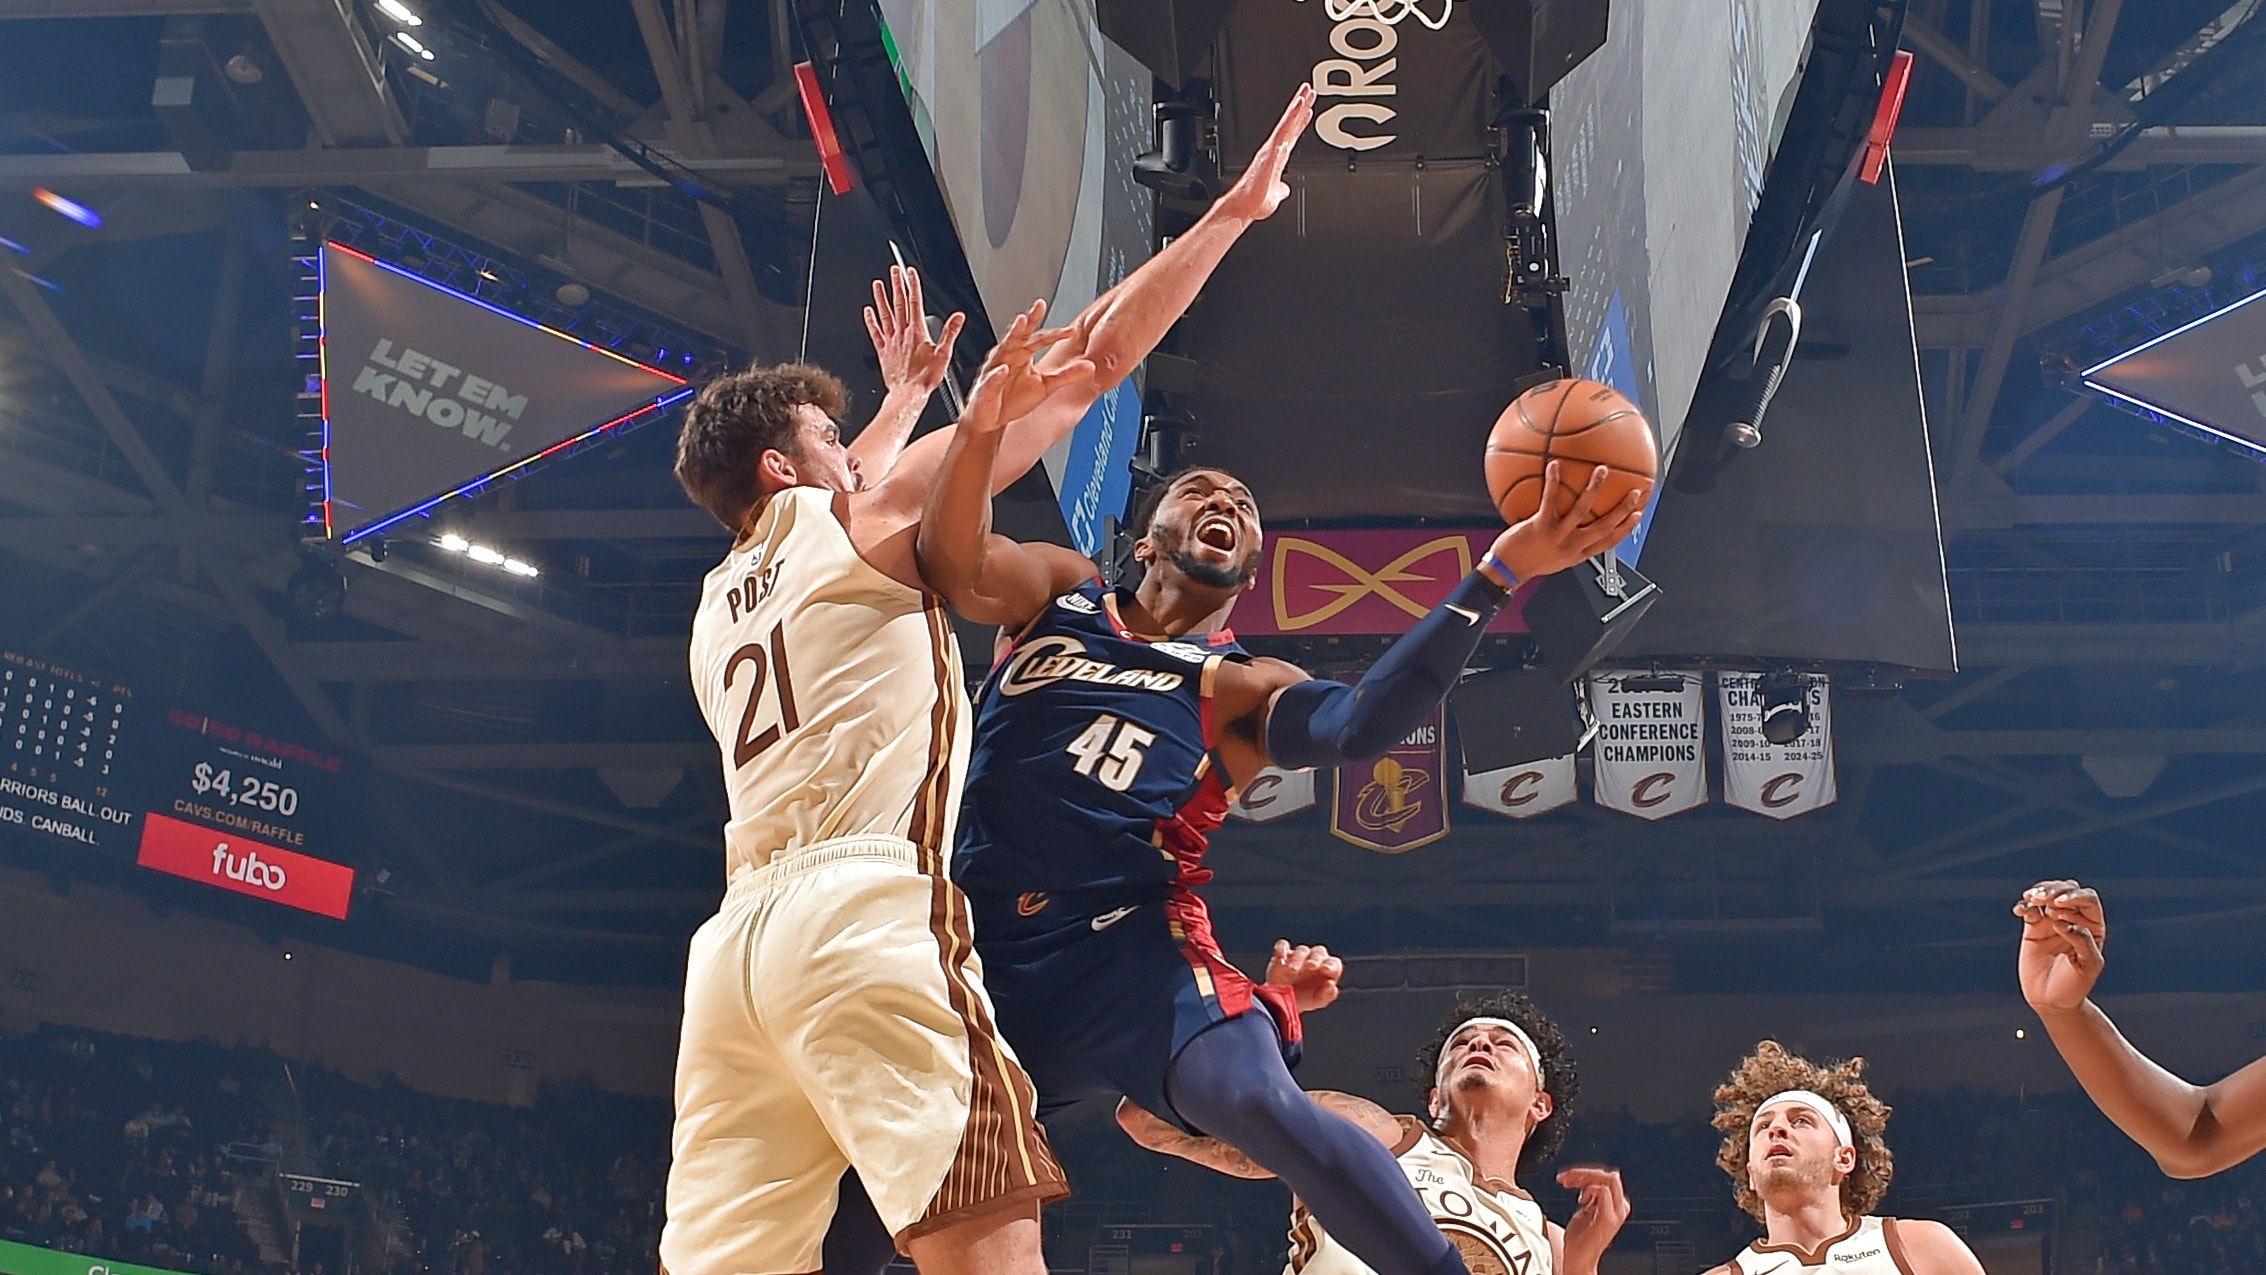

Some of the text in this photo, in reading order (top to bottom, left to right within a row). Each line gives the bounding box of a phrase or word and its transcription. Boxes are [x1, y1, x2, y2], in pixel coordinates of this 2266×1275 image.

[370, 338, 529, 420] LET EM
[352, 366, 513, 451] KNOW.
[1083, 409, 1114, 521] Cleveland
[726, 558, 786, 624] POST
[5, 670, 13, 680] 0
[28, 678, 36, 688] 0
[49, 683, 55, 693] 1
[66, 689, 74, 699] 0
[114, 704, 122, 714] 0
[724, 618, 800, 771] 21
[22, 709, 30, 719] 0
[42, 714, 48, 724] 1
[60, 720, 68, 730] 0
[108, 734, 116, 744] 2
[25, 694, 33, 704] 0
[44, 700, 52, 710] 0
[63, 705, 71, 715] 0
[111, 720, 119, 730] 0
[1611, 702, 1683, 719] EASTERN
[15, 740, 23, 750] 0
[34, 745, 42, 755] 0
[54, 750, 60, 760] 1
[18, 724, 26, 734] 0
[38, 730, 46, 740] 0
[56, 736, 64, 746] 0
[105, 750, 113, 760] 0
[1599, 723, 1699, 741] CONFERENCE
[1065, 714, 1157, 792] 45
[1604, 745, 1696, 762] CHAMPIONS
[1732, 751, 1824, 762] 2014-15 2024-25
[192, 762, 298, 816] $4,250
[100, 807, 132, 825] OUT
[173, 799, 304, 845] CAVS.COM/RAFFLE
[212, 843, 286, 890] fubo
[290, 1181, 348, 1197] 229 230
[1414, 1169, 1445, 1185] The
